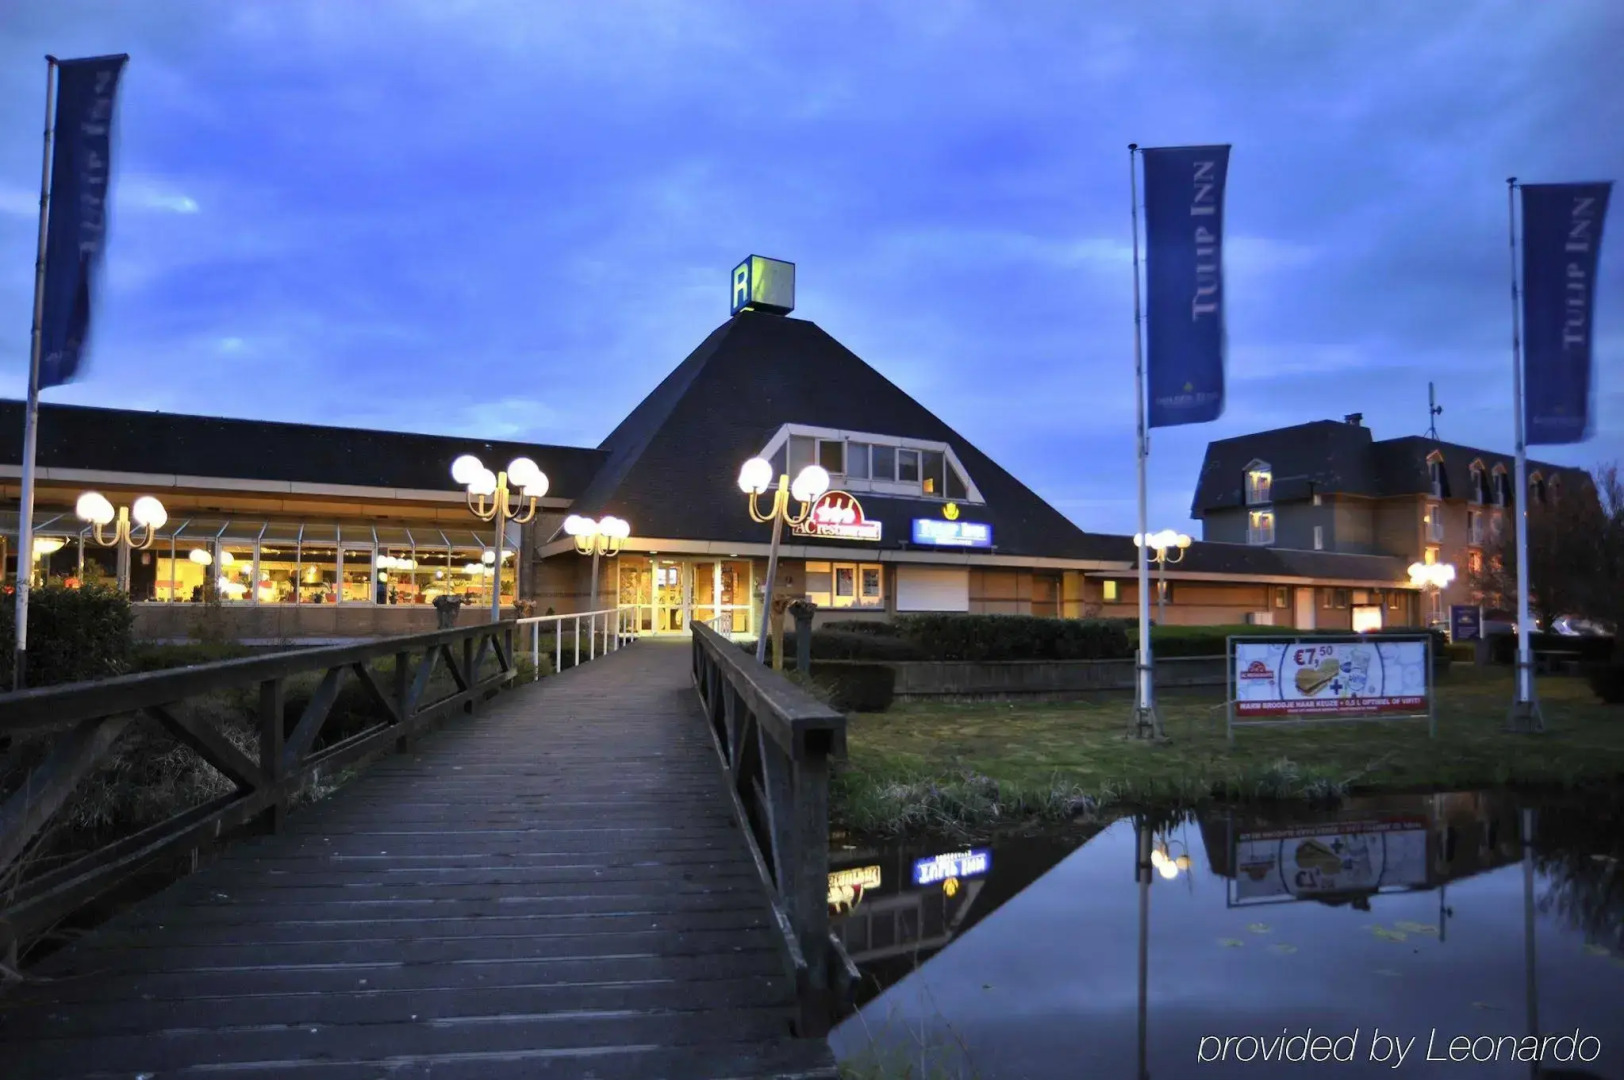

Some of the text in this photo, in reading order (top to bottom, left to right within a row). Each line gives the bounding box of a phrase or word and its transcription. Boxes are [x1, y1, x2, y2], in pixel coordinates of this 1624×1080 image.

[1190, 160, 1218, 322] TULIP INN
[1562, 195, 1596, 351] TULIP INN
[1262, 701, 1294, 709] BROODJE
